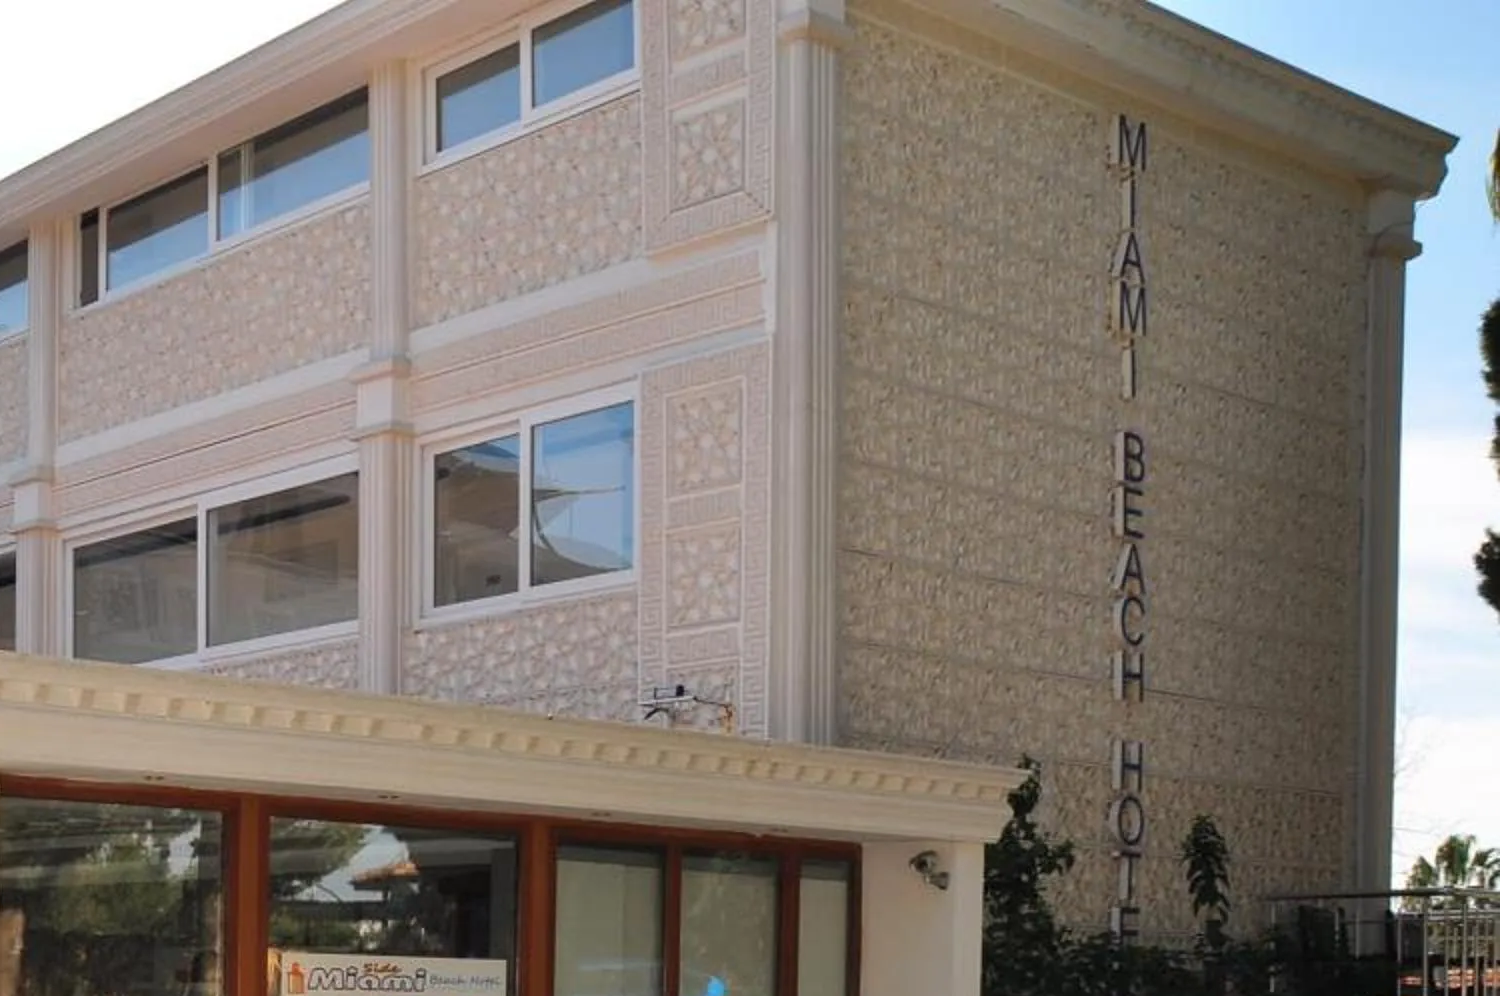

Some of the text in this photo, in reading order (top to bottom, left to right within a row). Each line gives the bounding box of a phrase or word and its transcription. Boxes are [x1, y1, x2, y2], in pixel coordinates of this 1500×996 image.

[1111, 114, 1147, 400] MIAMI
[1112, 431, 1146, 702] BEACH
[308, 966, 427, 991] Miami
